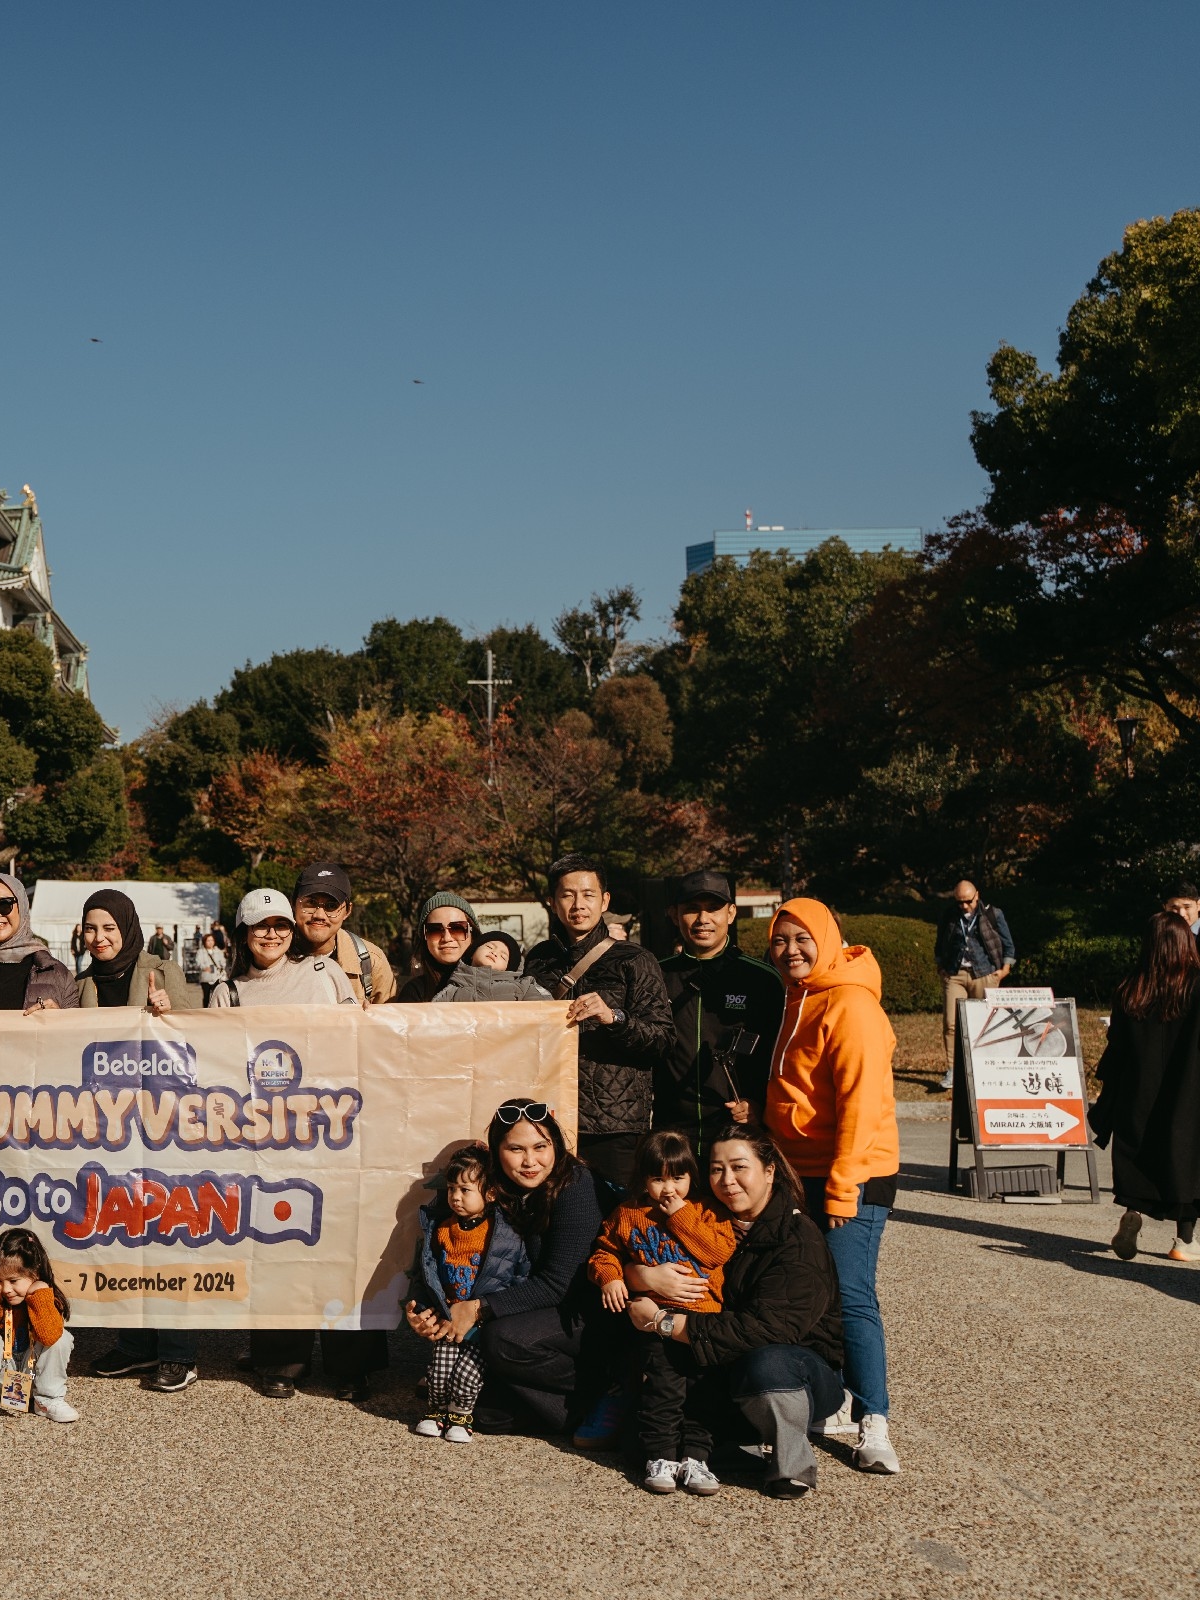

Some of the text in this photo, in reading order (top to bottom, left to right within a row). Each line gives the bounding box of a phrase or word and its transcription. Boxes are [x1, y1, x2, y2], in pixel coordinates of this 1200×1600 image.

[264, 895, 271, 904] B
[725, 994, 747, 1004] 1967
[93, 1051, 188, 1076] Bebelac
[1029, 1121, 1053, 1129] 大阪城
[35, 1181, 72, 1215] to
[63, 1172, 241, 1240] JAPAN
[79, 1272, 88, 1291] 7
[94, 1271, 187, 1292] December
[193, 1272, 235, 1292] 2024
